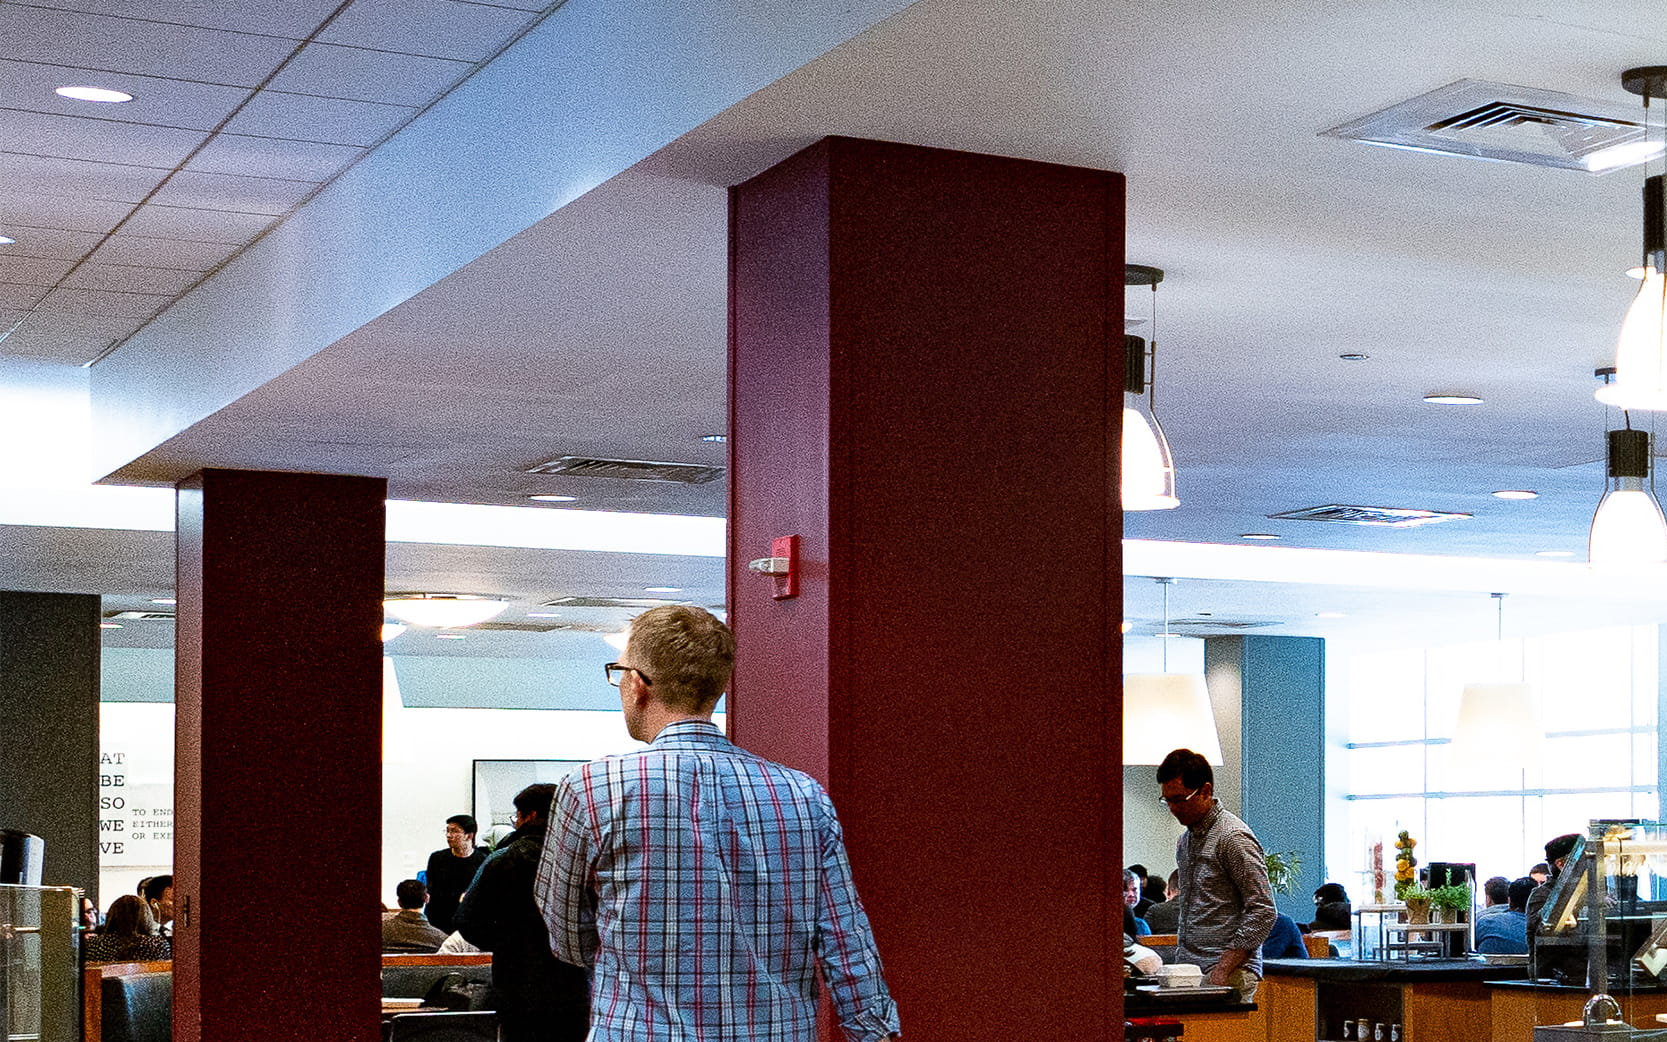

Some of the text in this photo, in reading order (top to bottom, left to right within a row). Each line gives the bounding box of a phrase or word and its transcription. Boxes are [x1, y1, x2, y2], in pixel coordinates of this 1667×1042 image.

[100, 752, 126, 765] AT
[100, 774, 125, 787] BE
[100, 796, 125, 810] SO
[132, 808, 146, 816] TO
[100, 819, 125, 832] WE
[132, 820, 174, 828] EITHER
[132, 832, 146, 840] OR
[100, 842, 124, 854] VE
